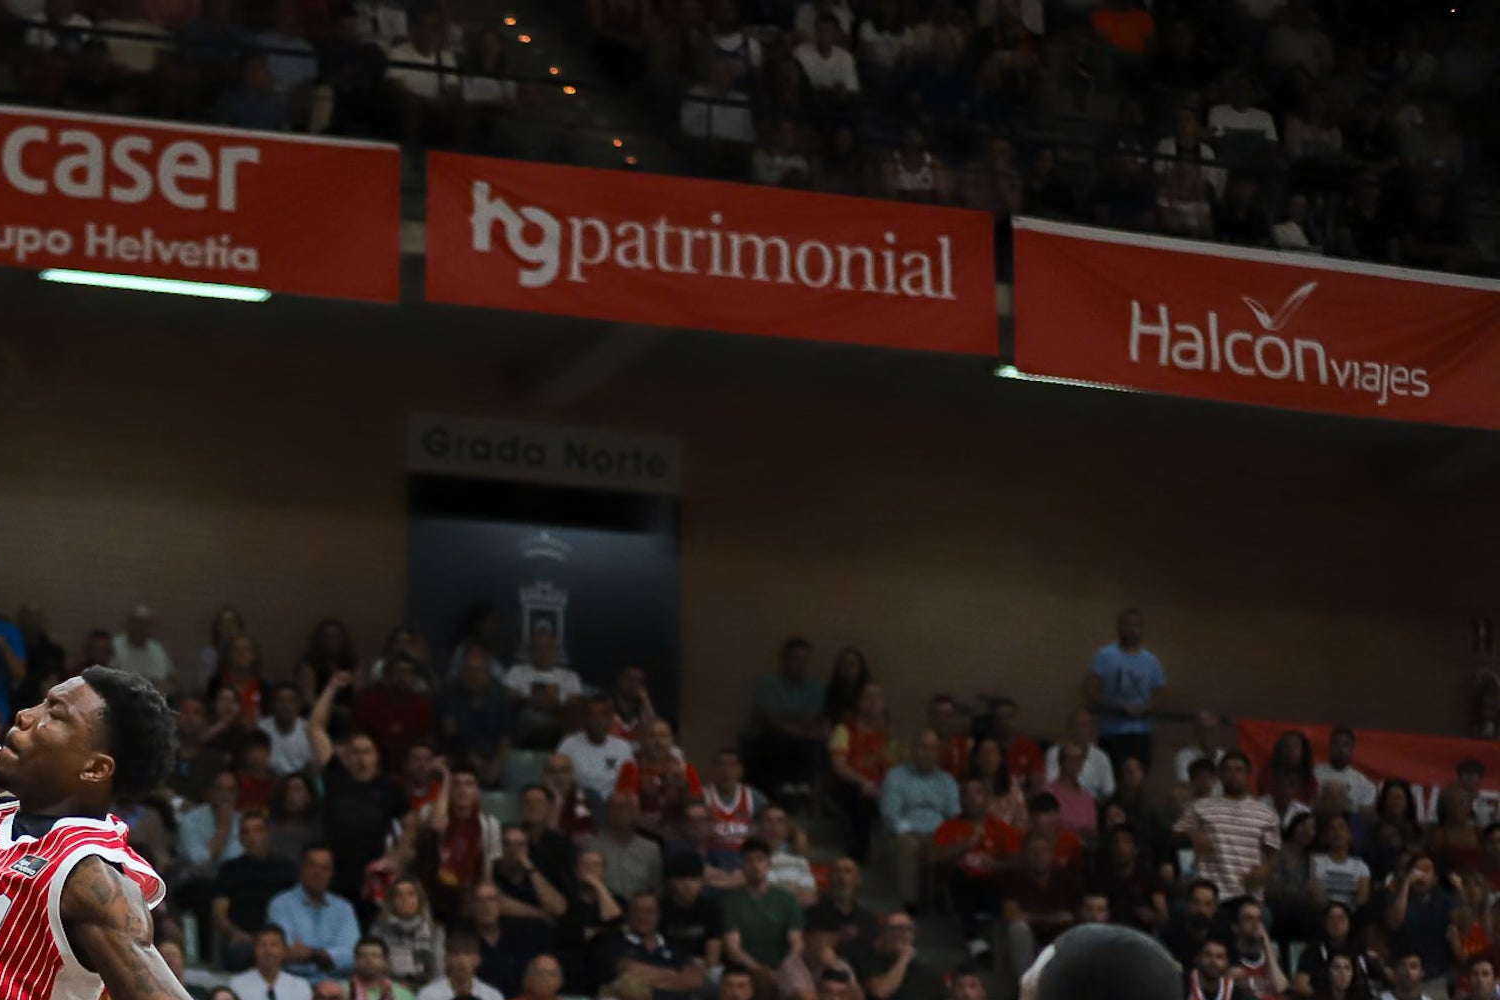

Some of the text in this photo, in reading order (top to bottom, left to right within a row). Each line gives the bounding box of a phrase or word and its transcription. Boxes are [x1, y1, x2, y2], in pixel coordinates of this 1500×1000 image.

[2, 124, 260, 211] caser
[86, 223, 260, 272] Helvetia
[568, 212, 955, 300] patrimonial
[1330, 359, 1431, 406] viajes
[422, 427, 670, 478] Grada Norte
